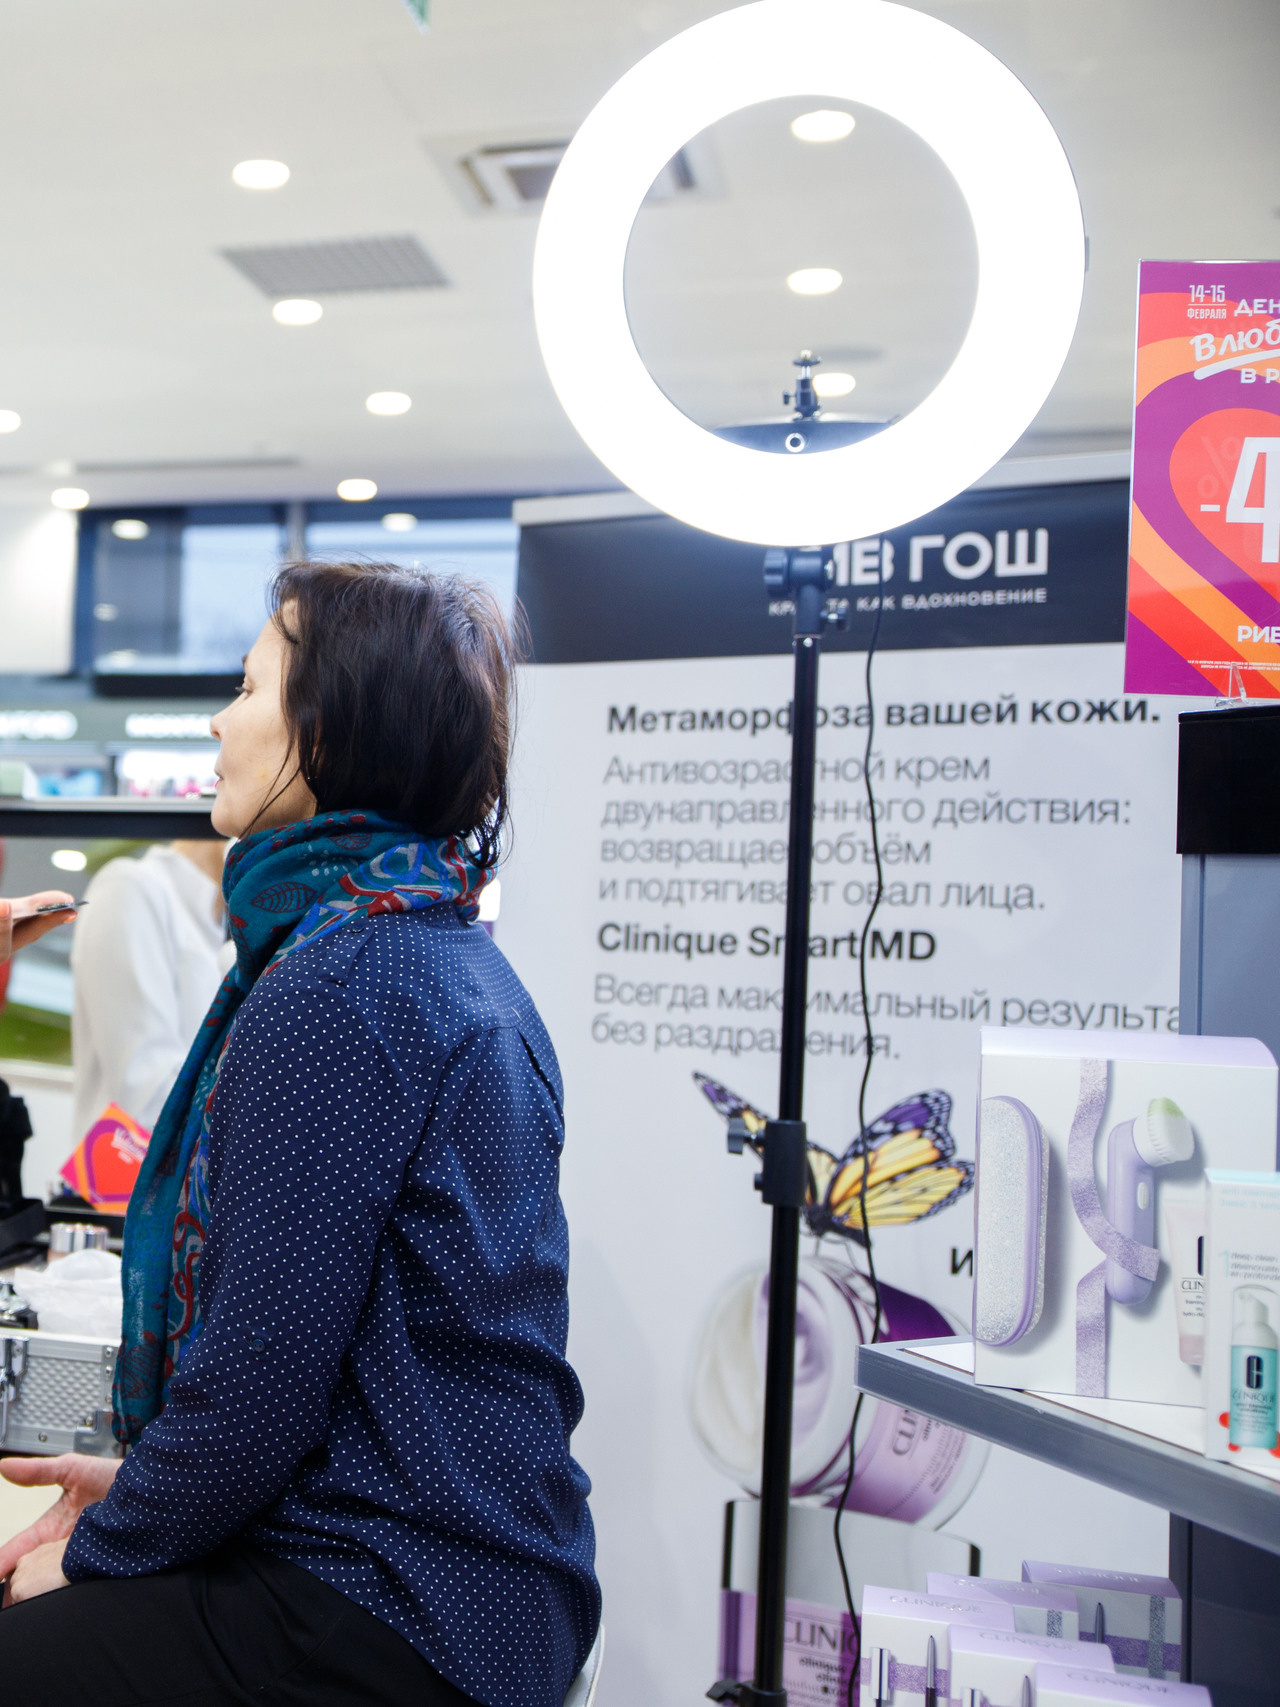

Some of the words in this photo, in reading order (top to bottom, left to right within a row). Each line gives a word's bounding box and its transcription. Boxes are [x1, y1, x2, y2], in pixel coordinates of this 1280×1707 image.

[1189, 285, 1225, 303] 14-15
[1187, 308, 1227, 320] ФЕВРАЛЯ
[1240, 368, 1257, 384] В
[909, 527, 1049, 583] ГОШ
[901, 587, 1048, 611] ВДОХНОВЕНИЕ
[885, 693, 1018, 726] вашей
[1030, 699, 1161, 723] кожи.
[603, 752, 885, 789] Антивозраной
[894, 756, 990, 788] крем
[601, 798, 925, 830] двунаправнного
[932, 790, 1131, 829] действия:
[600, 836, 789, 868] возвращае
[812, 832, 932, 866] объём
[599, 879, 617, 901] и
[624, 878, 836, 908] подтягиват
[842, 881, 932, 908] овал
[939, 883, 1045, 915] лица.
[598, 922, 737, 961] Clinique
[870, 930, 936, 960] MD
[593, 974, 709, 1012] Всегда
[717, 986, 991, 1022] макимальный
[591, 1011, 647, 1046] без
[655, 1022, 900, 1060] раздраения.
[889, 1595, 984, 1614] CLINIQUE
[979, 1632, 1081, 1651] CLINIQUE
